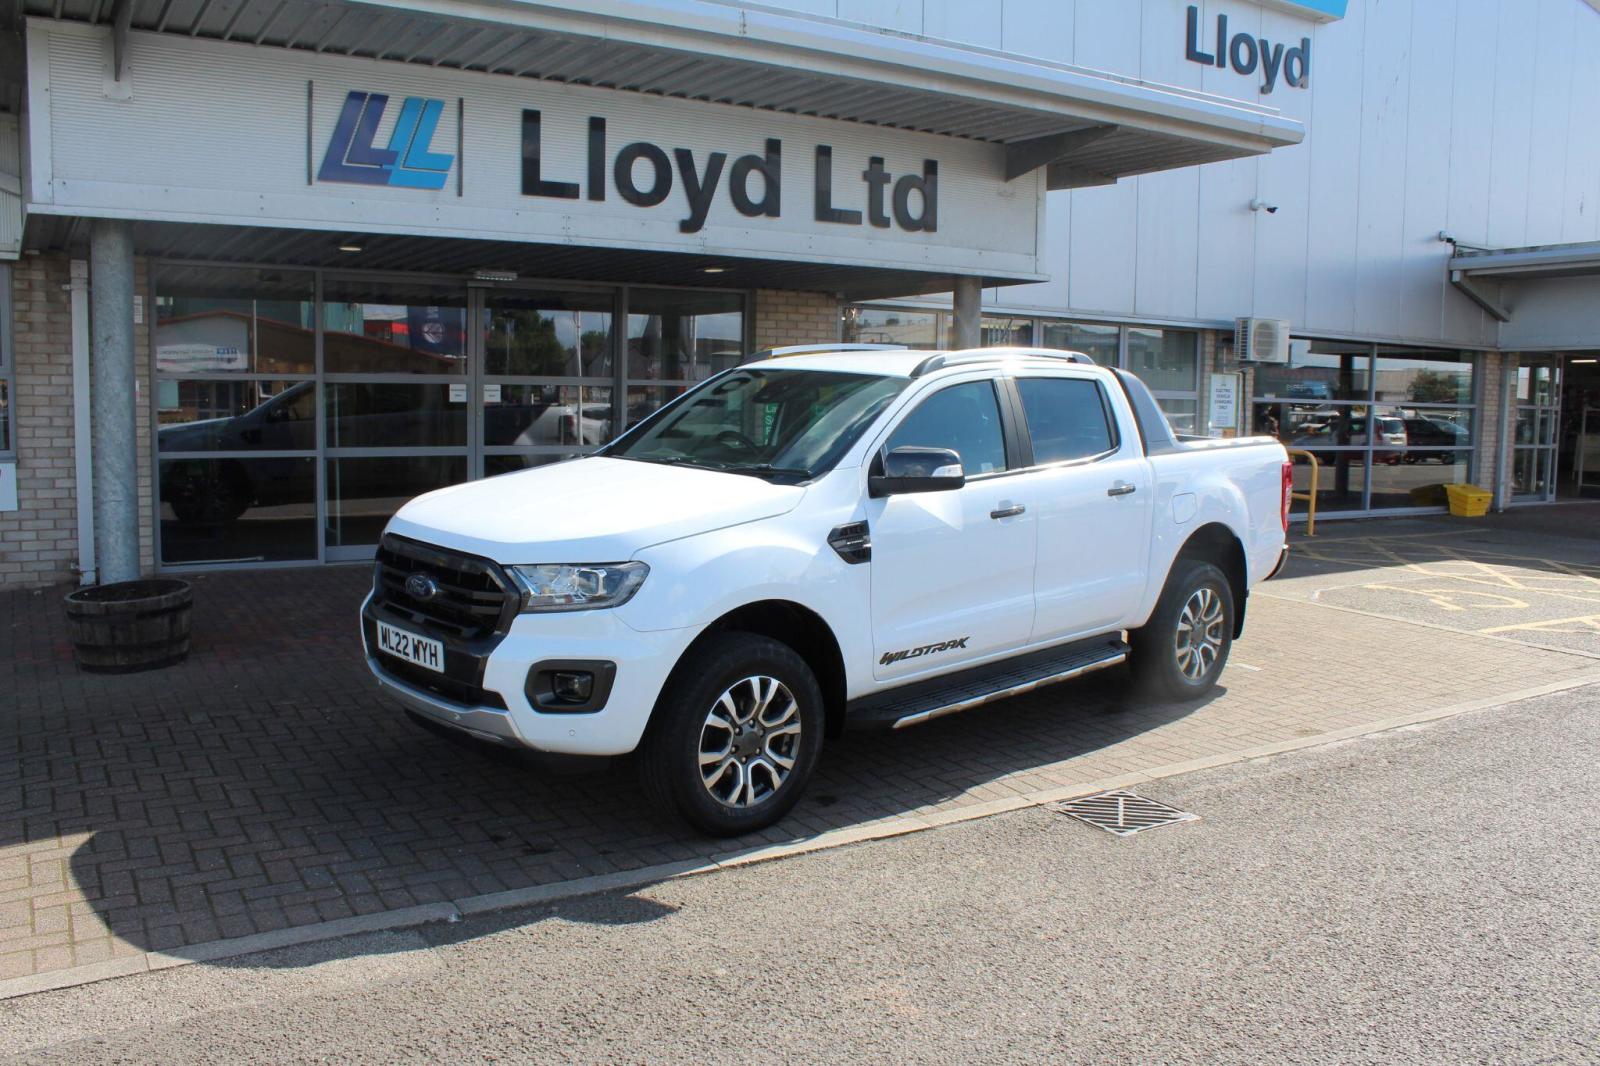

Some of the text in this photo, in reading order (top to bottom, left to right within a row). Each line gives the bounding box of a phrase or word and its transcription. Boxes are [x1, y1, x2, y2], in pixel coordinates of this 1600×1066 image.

[1186, 5, 1311, 95] Lloyd
[520, 108, 938, 233] Lloyd Ltd
[412, 637, 438, 667] WYH
[879, 636, 970, 665] WILDTRAK
